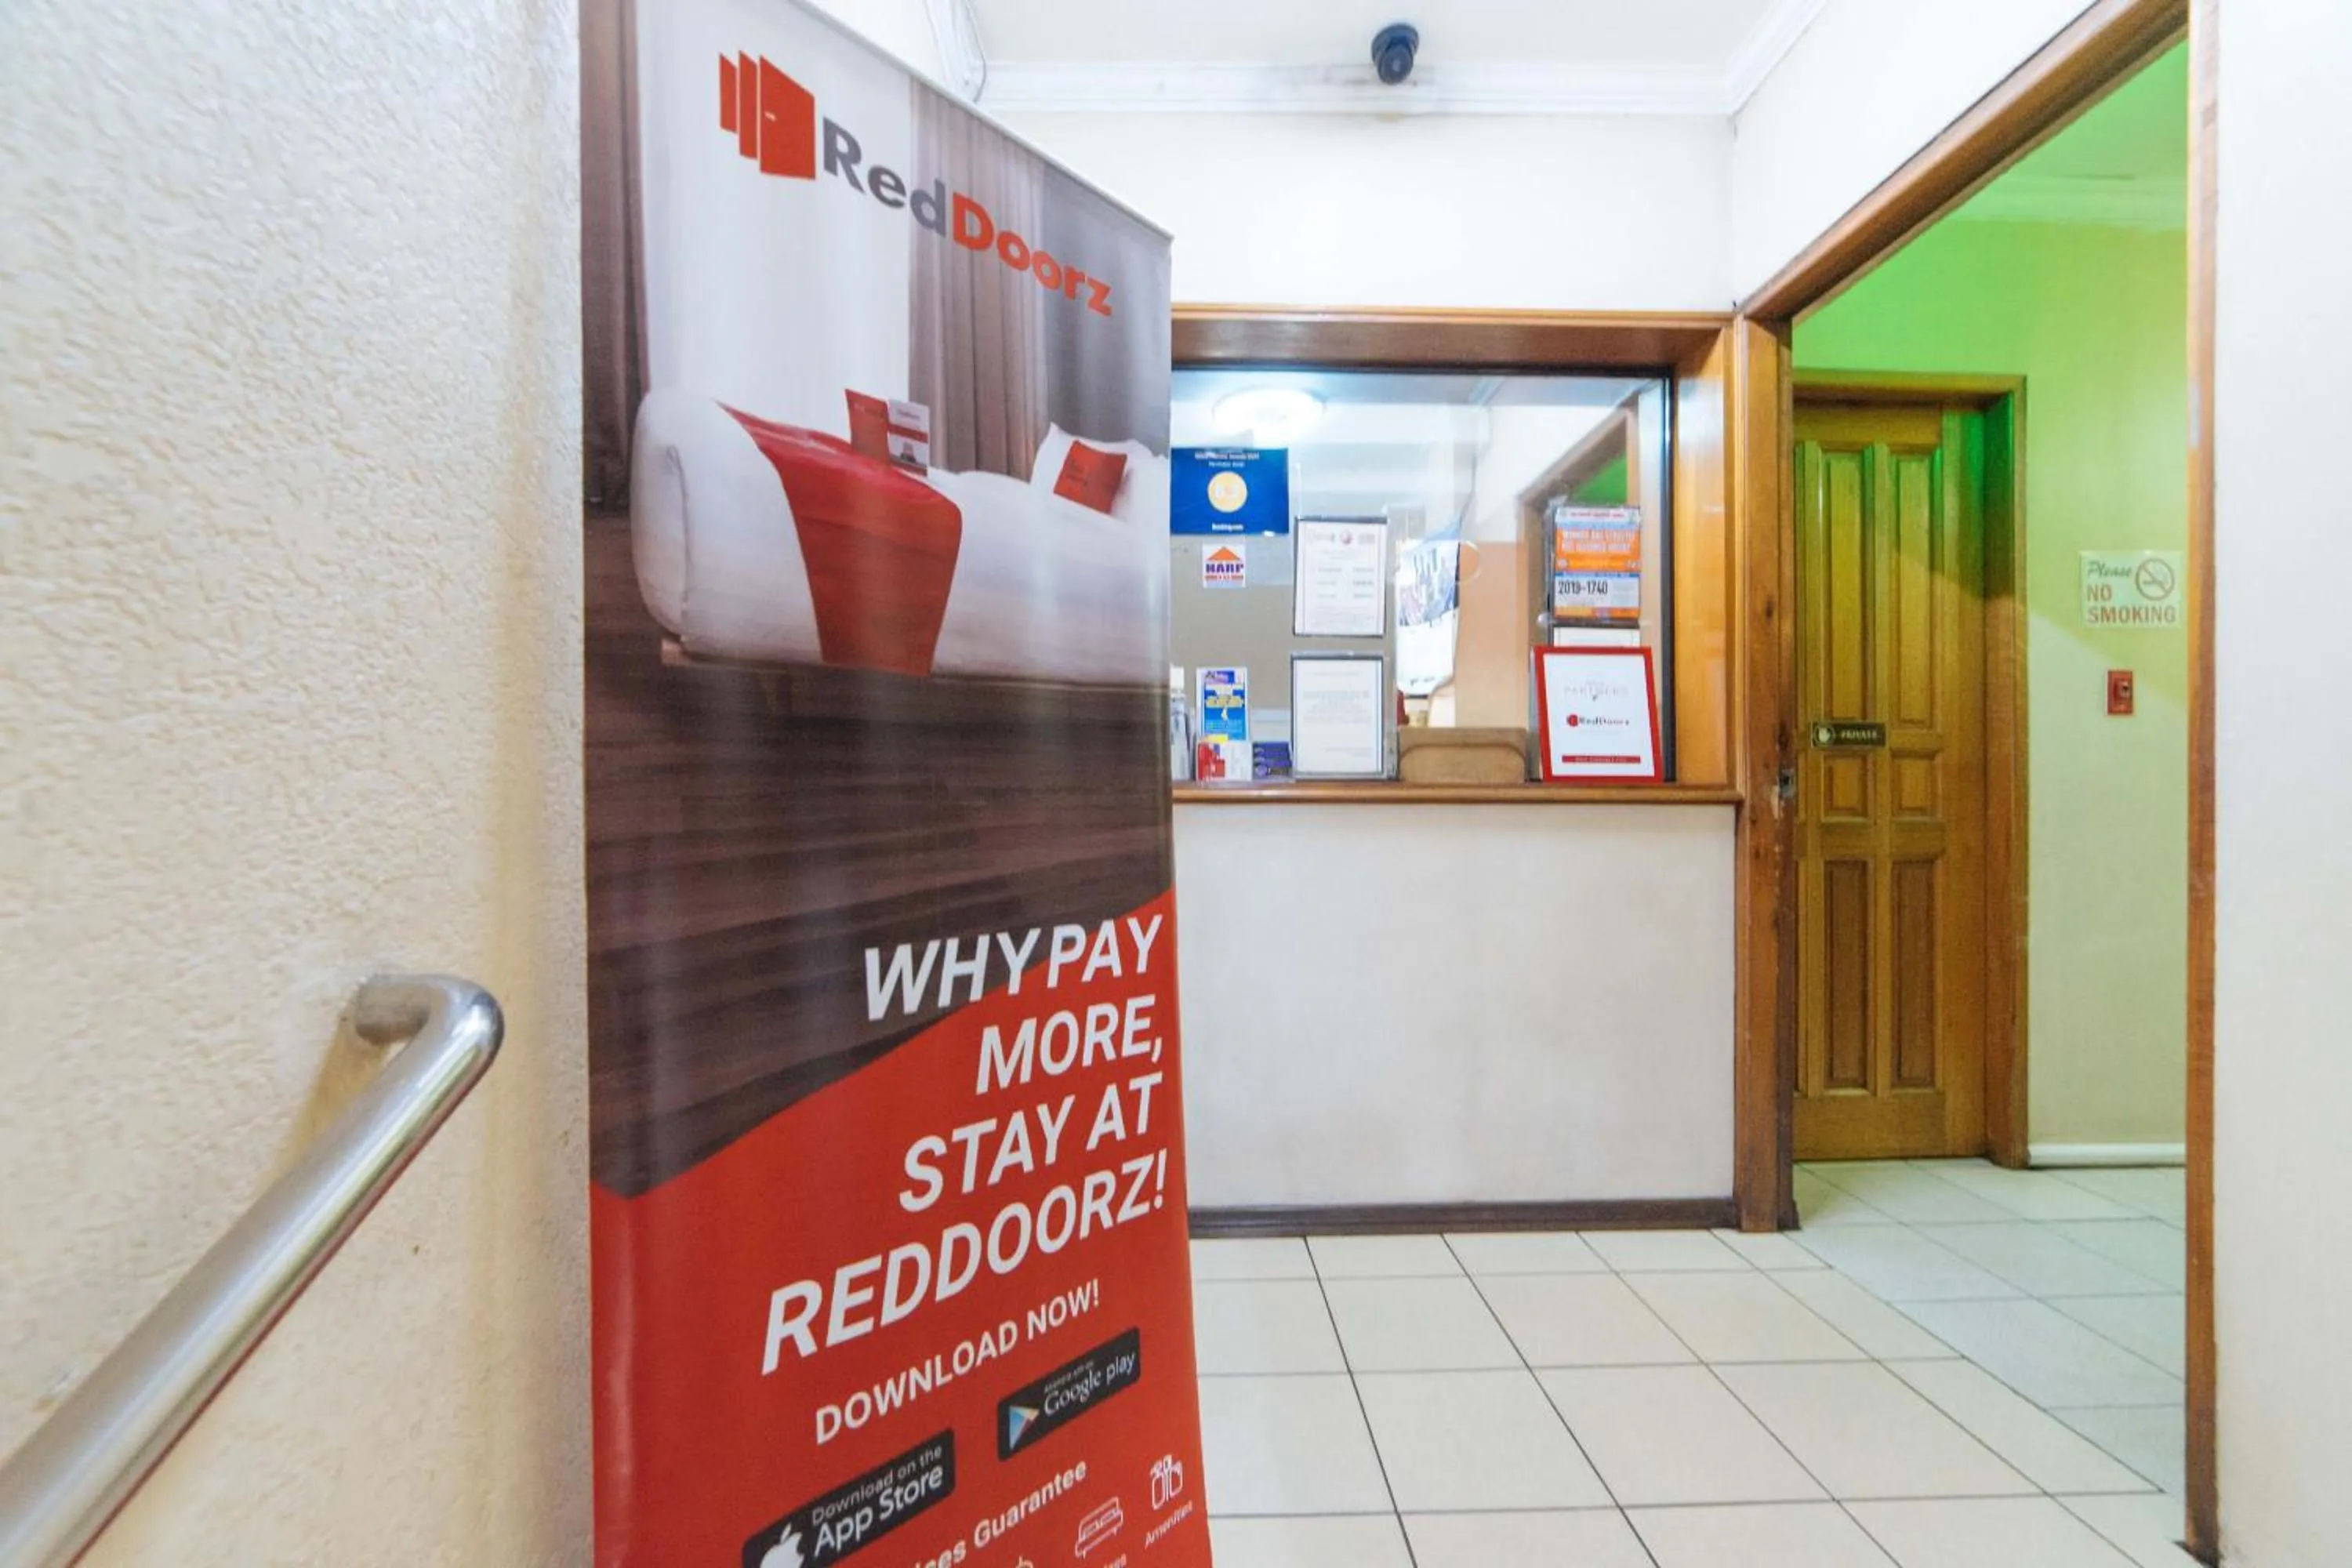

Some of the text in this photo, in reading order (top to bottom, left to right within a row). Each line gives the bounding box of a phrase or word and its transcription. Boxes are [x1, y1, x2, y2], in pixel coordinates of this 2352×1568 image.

[822, 116, 1113, 318] RedDoorz
[2086, 583, 2113, 602] NO
[2087, 604, 2176, 624] SMOKING
[865, 914, 1163, 1022] WHY PAY
[976, 994, 1163, 1095] MORE,
[898, 1073, 1163, 1213] STAY AT
[761, 1149, 1168, 1376] REDDOORZ!
[815, 1279, 1099, 1445] DOWNLOAD NOW!
[1044, 1351, 1136, 1417] Google play
[812, 1446, 942, 1526] Download on the
[813, 1464, 944, 1558] App Store
[973, 1461, 1087, 1548] Guarantee
